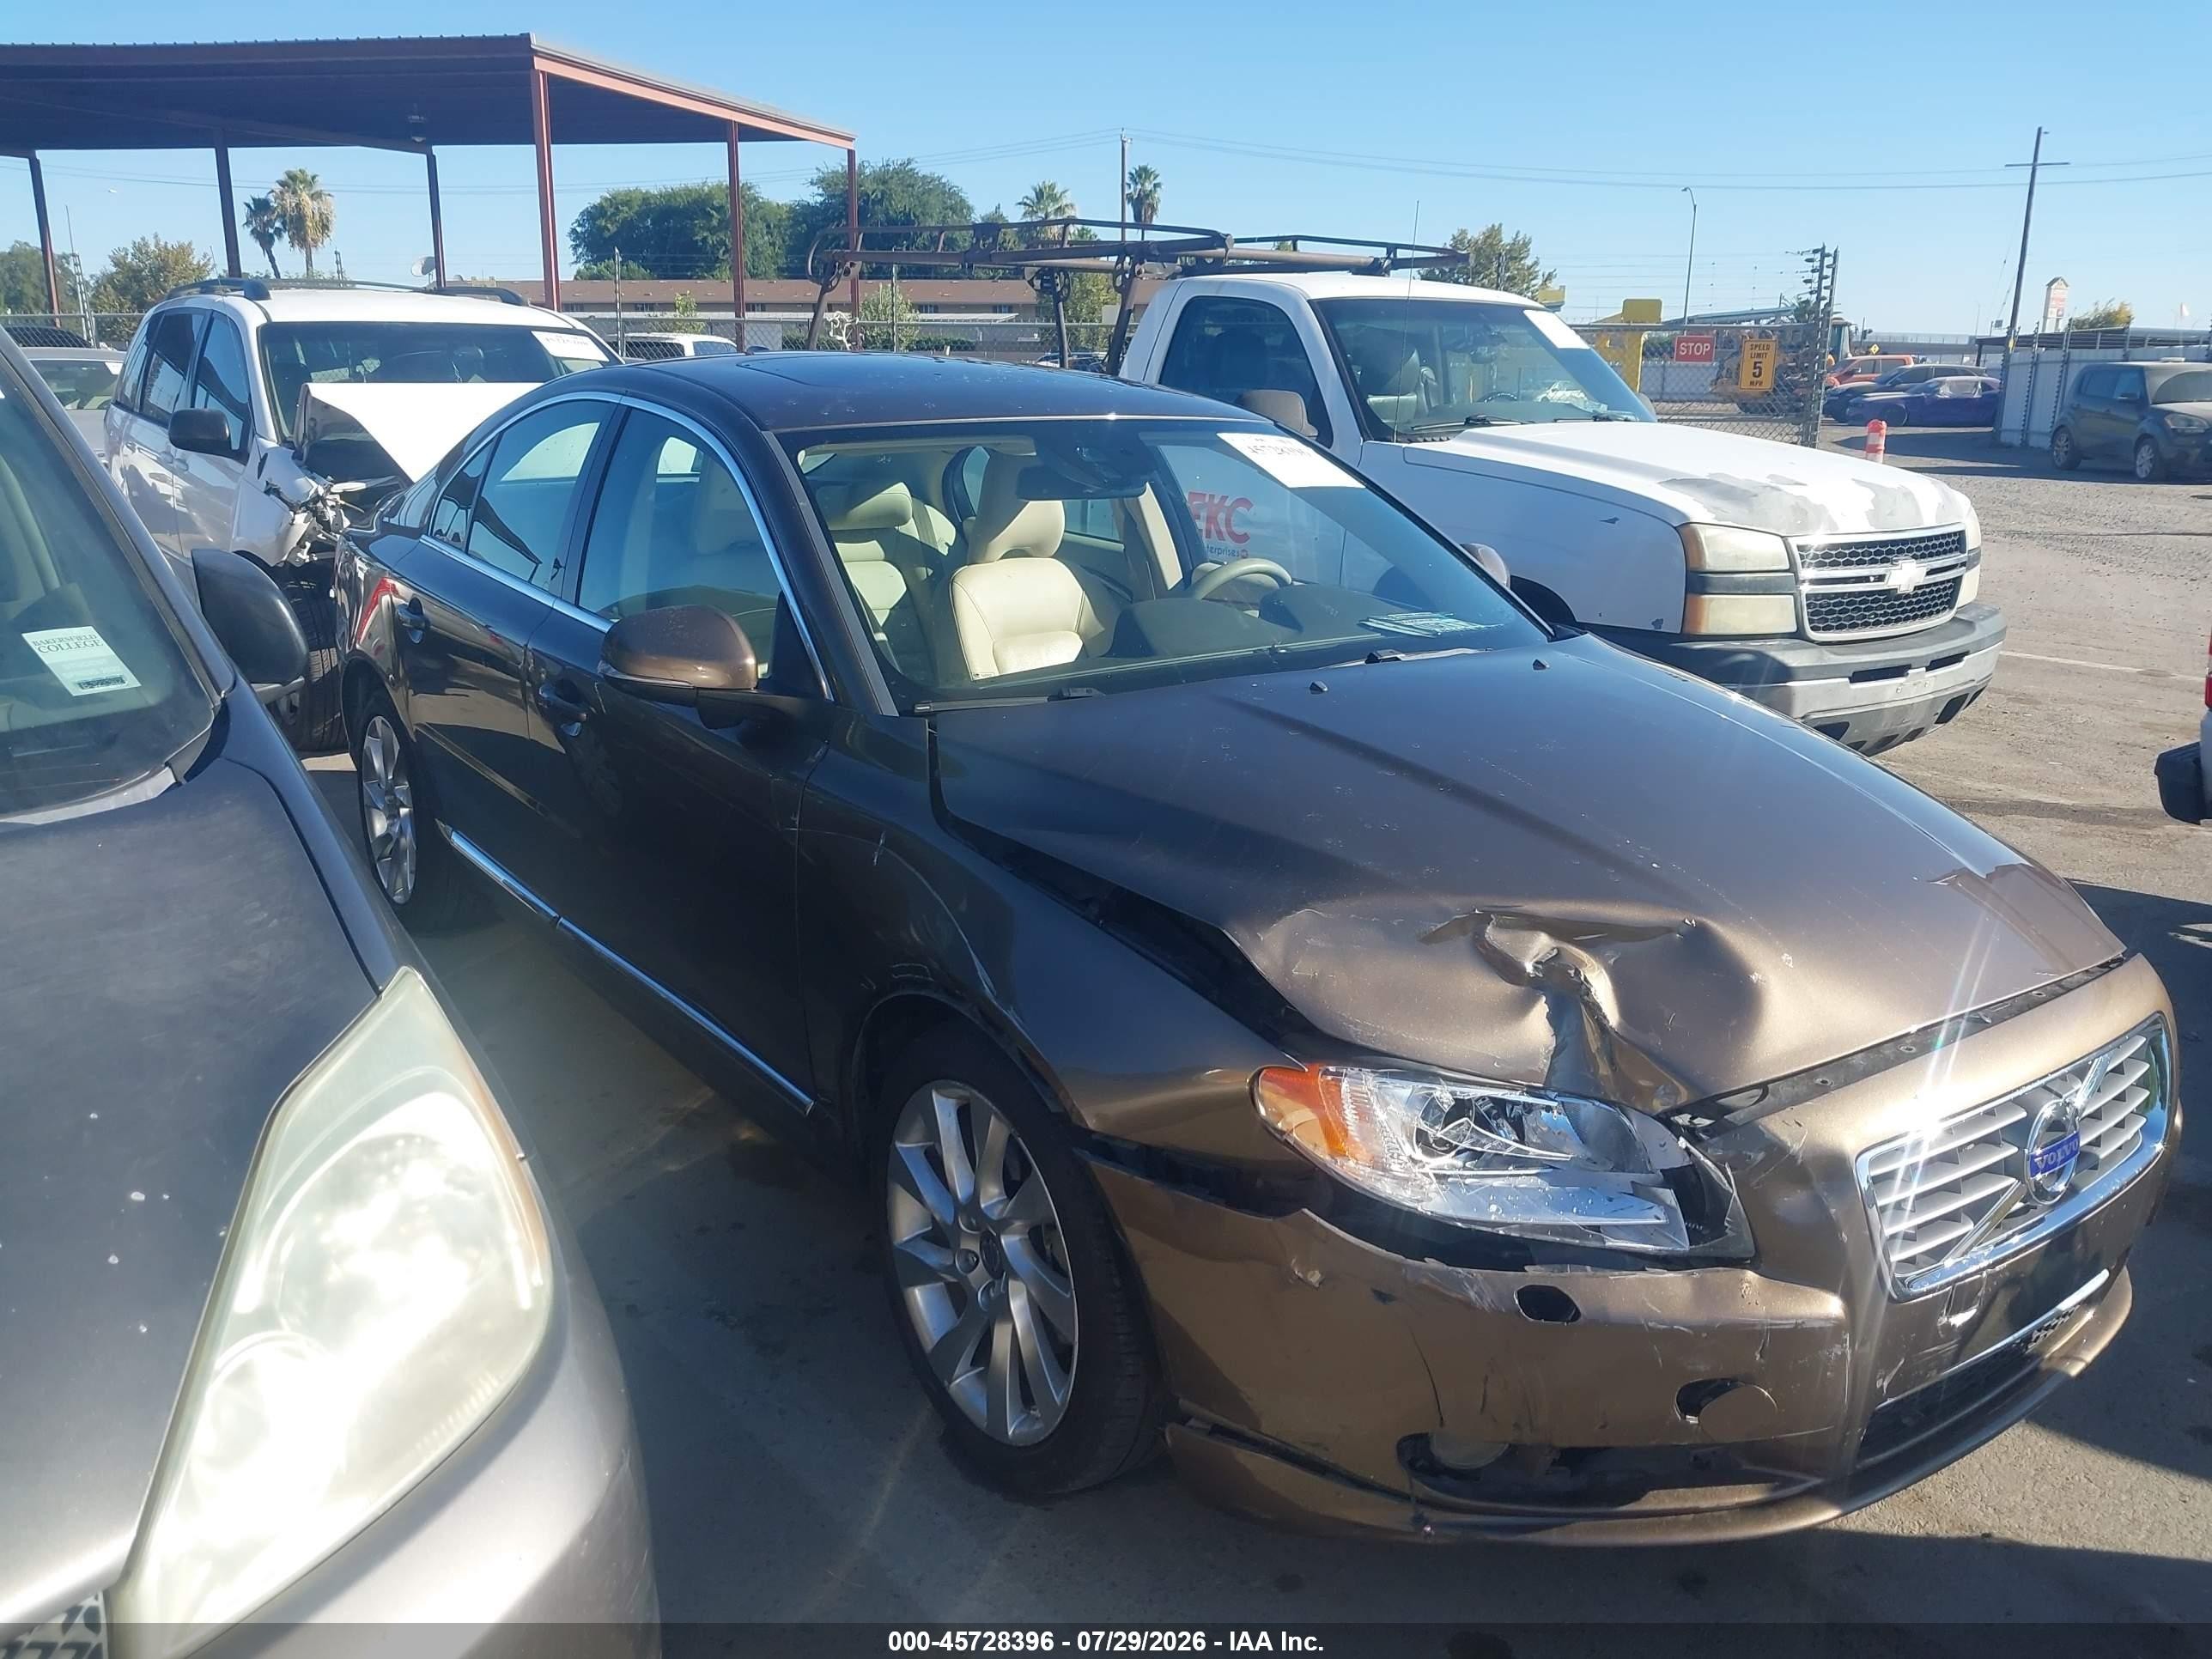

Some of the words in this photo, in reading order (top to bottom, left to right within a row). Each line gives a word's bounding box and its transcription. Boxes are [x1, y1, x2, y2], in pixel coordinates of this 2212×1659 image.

[1679, 343, 1711, 356] STOP
[1752, 361, 1763, 378] 5
[1206, 544, 1240, 557] terprises
[31, 635, 97, 646] BAKERSFIELD
[37, 639, 104, 653] COLLEGE
[2034, 1139, 2079, 1169] VOLVO
